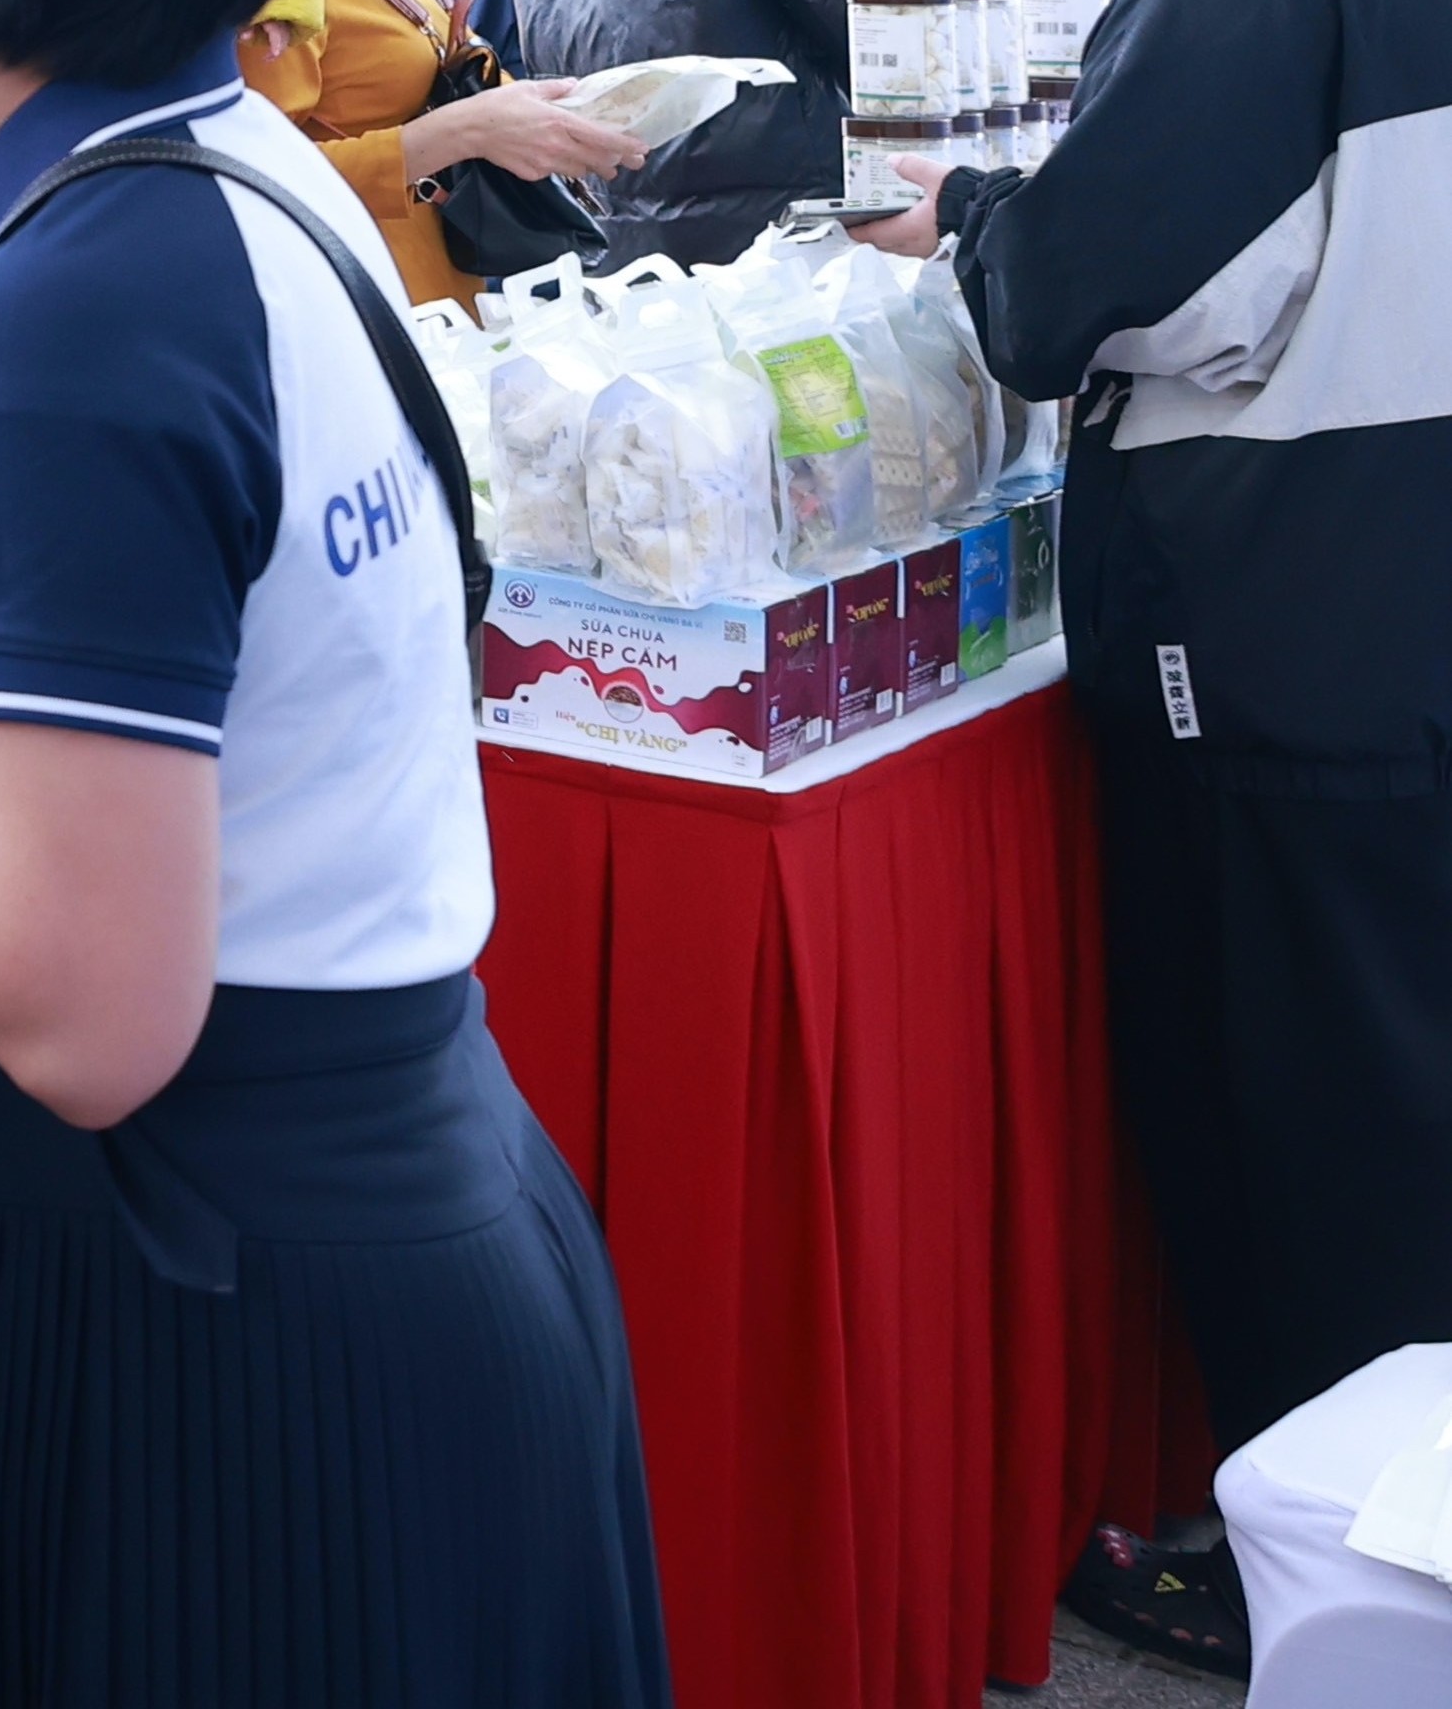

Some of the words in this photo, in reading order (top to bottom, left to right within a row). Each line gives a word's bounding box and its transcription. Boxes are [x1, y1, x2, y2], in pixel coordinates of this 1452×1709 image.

[548, 596, 572, 608] CÔNG
[573, 599, 584, 610] TY
[581, 619, 613, 636] SỮA
[618, 626, 665, 644] CHUA
[626, 725, 688, 753] VÀNG”
